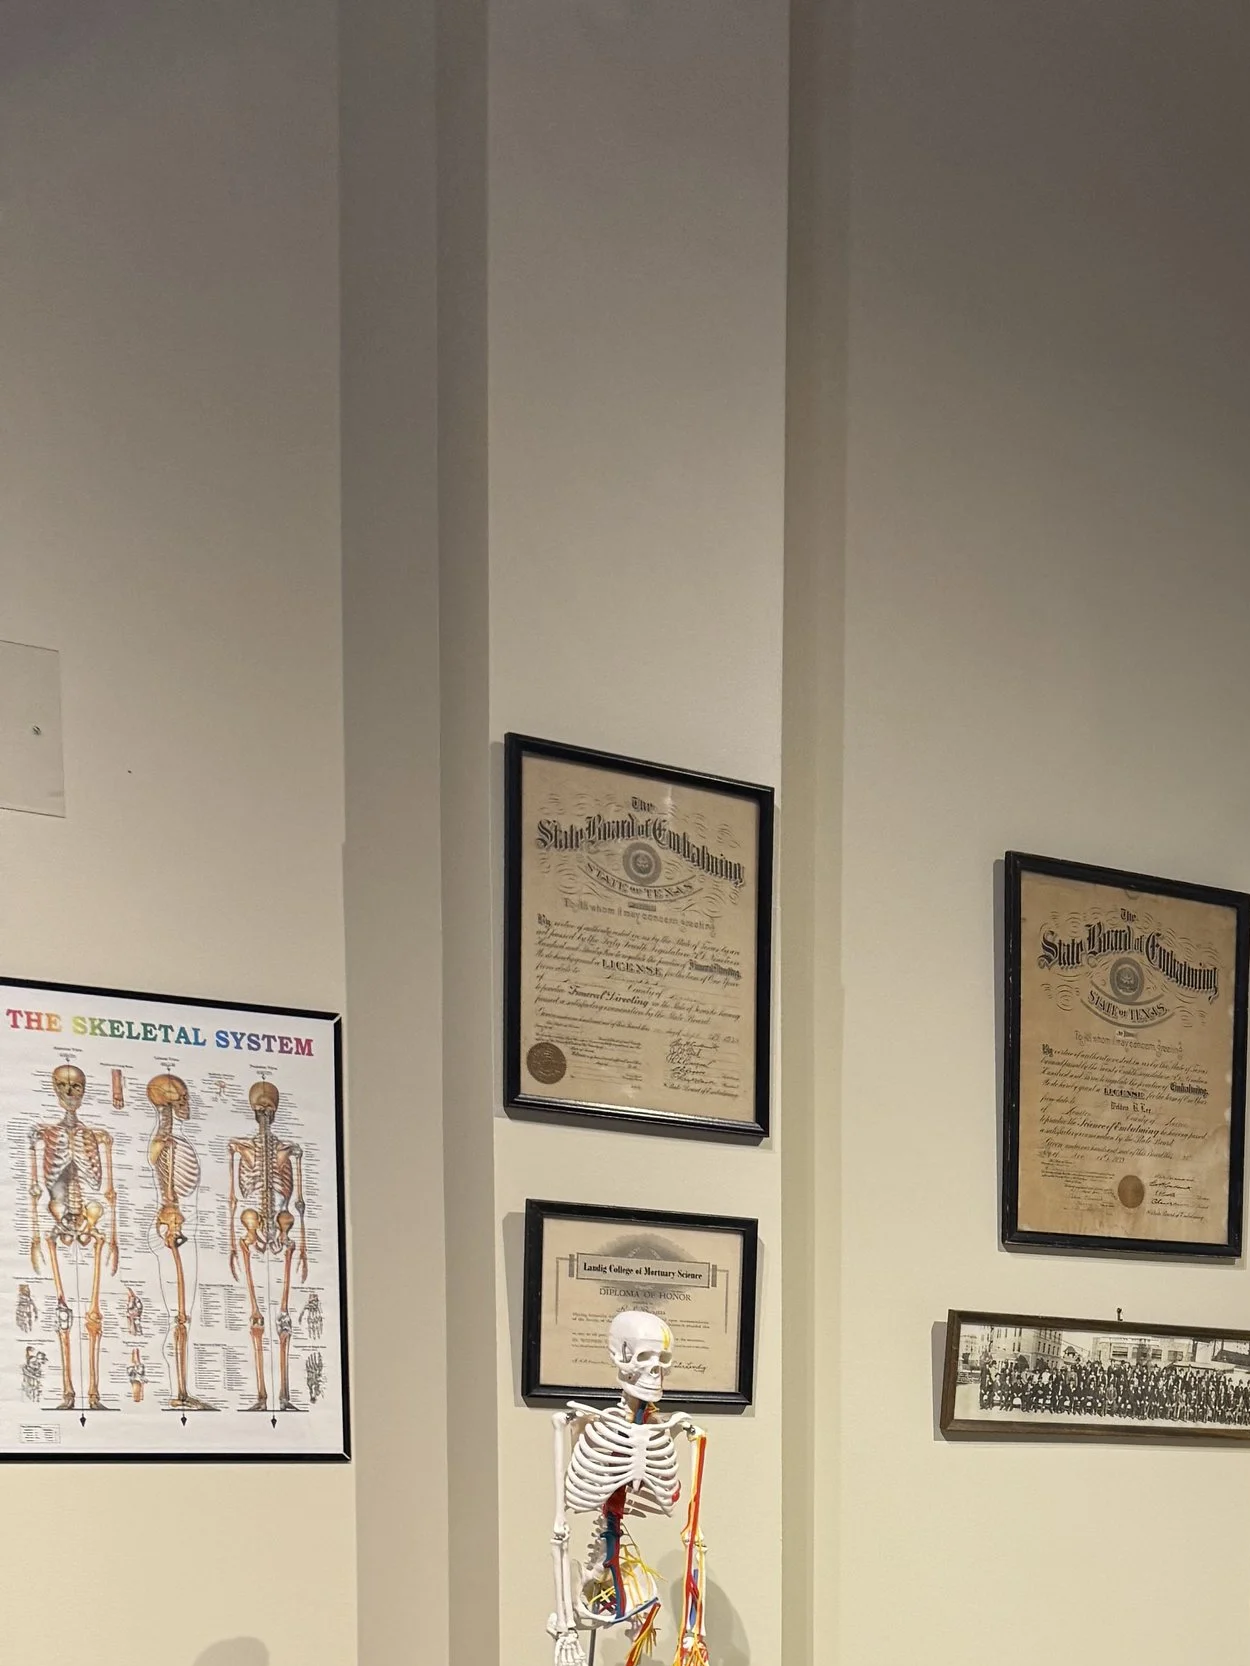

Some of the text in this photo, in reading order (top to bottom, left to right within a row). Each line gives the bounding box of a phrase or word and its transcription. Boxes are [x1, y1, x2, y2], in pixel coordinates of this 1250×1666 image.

[537, 813, 745, 887] State Board of Embalming
[1121, 908, 1137, 922] The
[602, 959, 663, 977] LICENSE
[1038, 922, 1219, 1003] State Board of Embalming
[1088, 990, 1119, 1018] STATE
[6, 1009, 315, 1057] THE SKELETAL SYSTEM
[1104, 1087, 1145, 1099] LICENSE
[584, 1262, 702, 1279] Landig College of Mortuary Science
[600, 1288, 692, 1301] DIPLOMA OF HONOR
